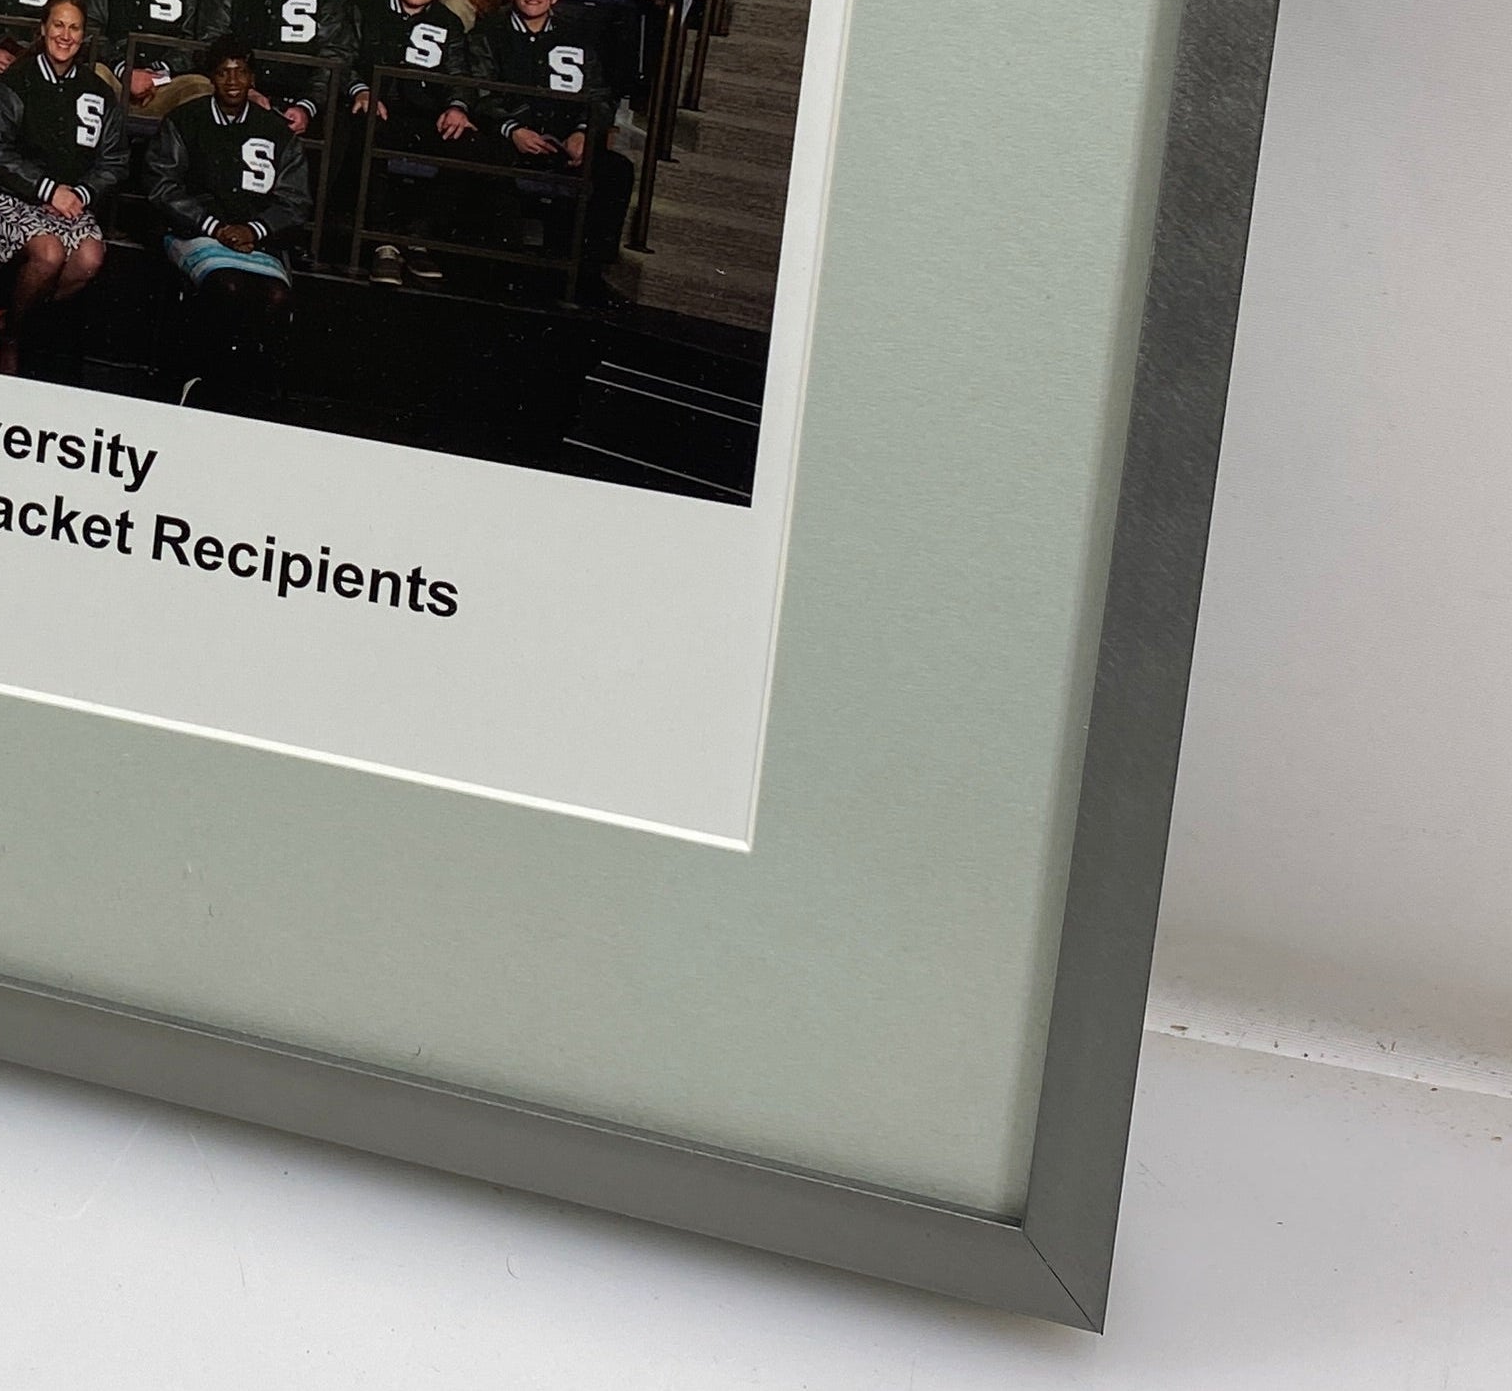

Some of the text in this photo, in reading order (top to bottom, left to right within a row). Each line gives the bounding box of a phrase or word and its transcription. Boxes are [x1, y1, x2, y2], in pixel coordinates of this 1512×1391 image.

[406, 24, 447, 67] S
[548, 46, 584, 93] S
[77, 93, 104, 147] S
[242, 138, 275, 193] S
[151, 514, 458, 618] Recipients
